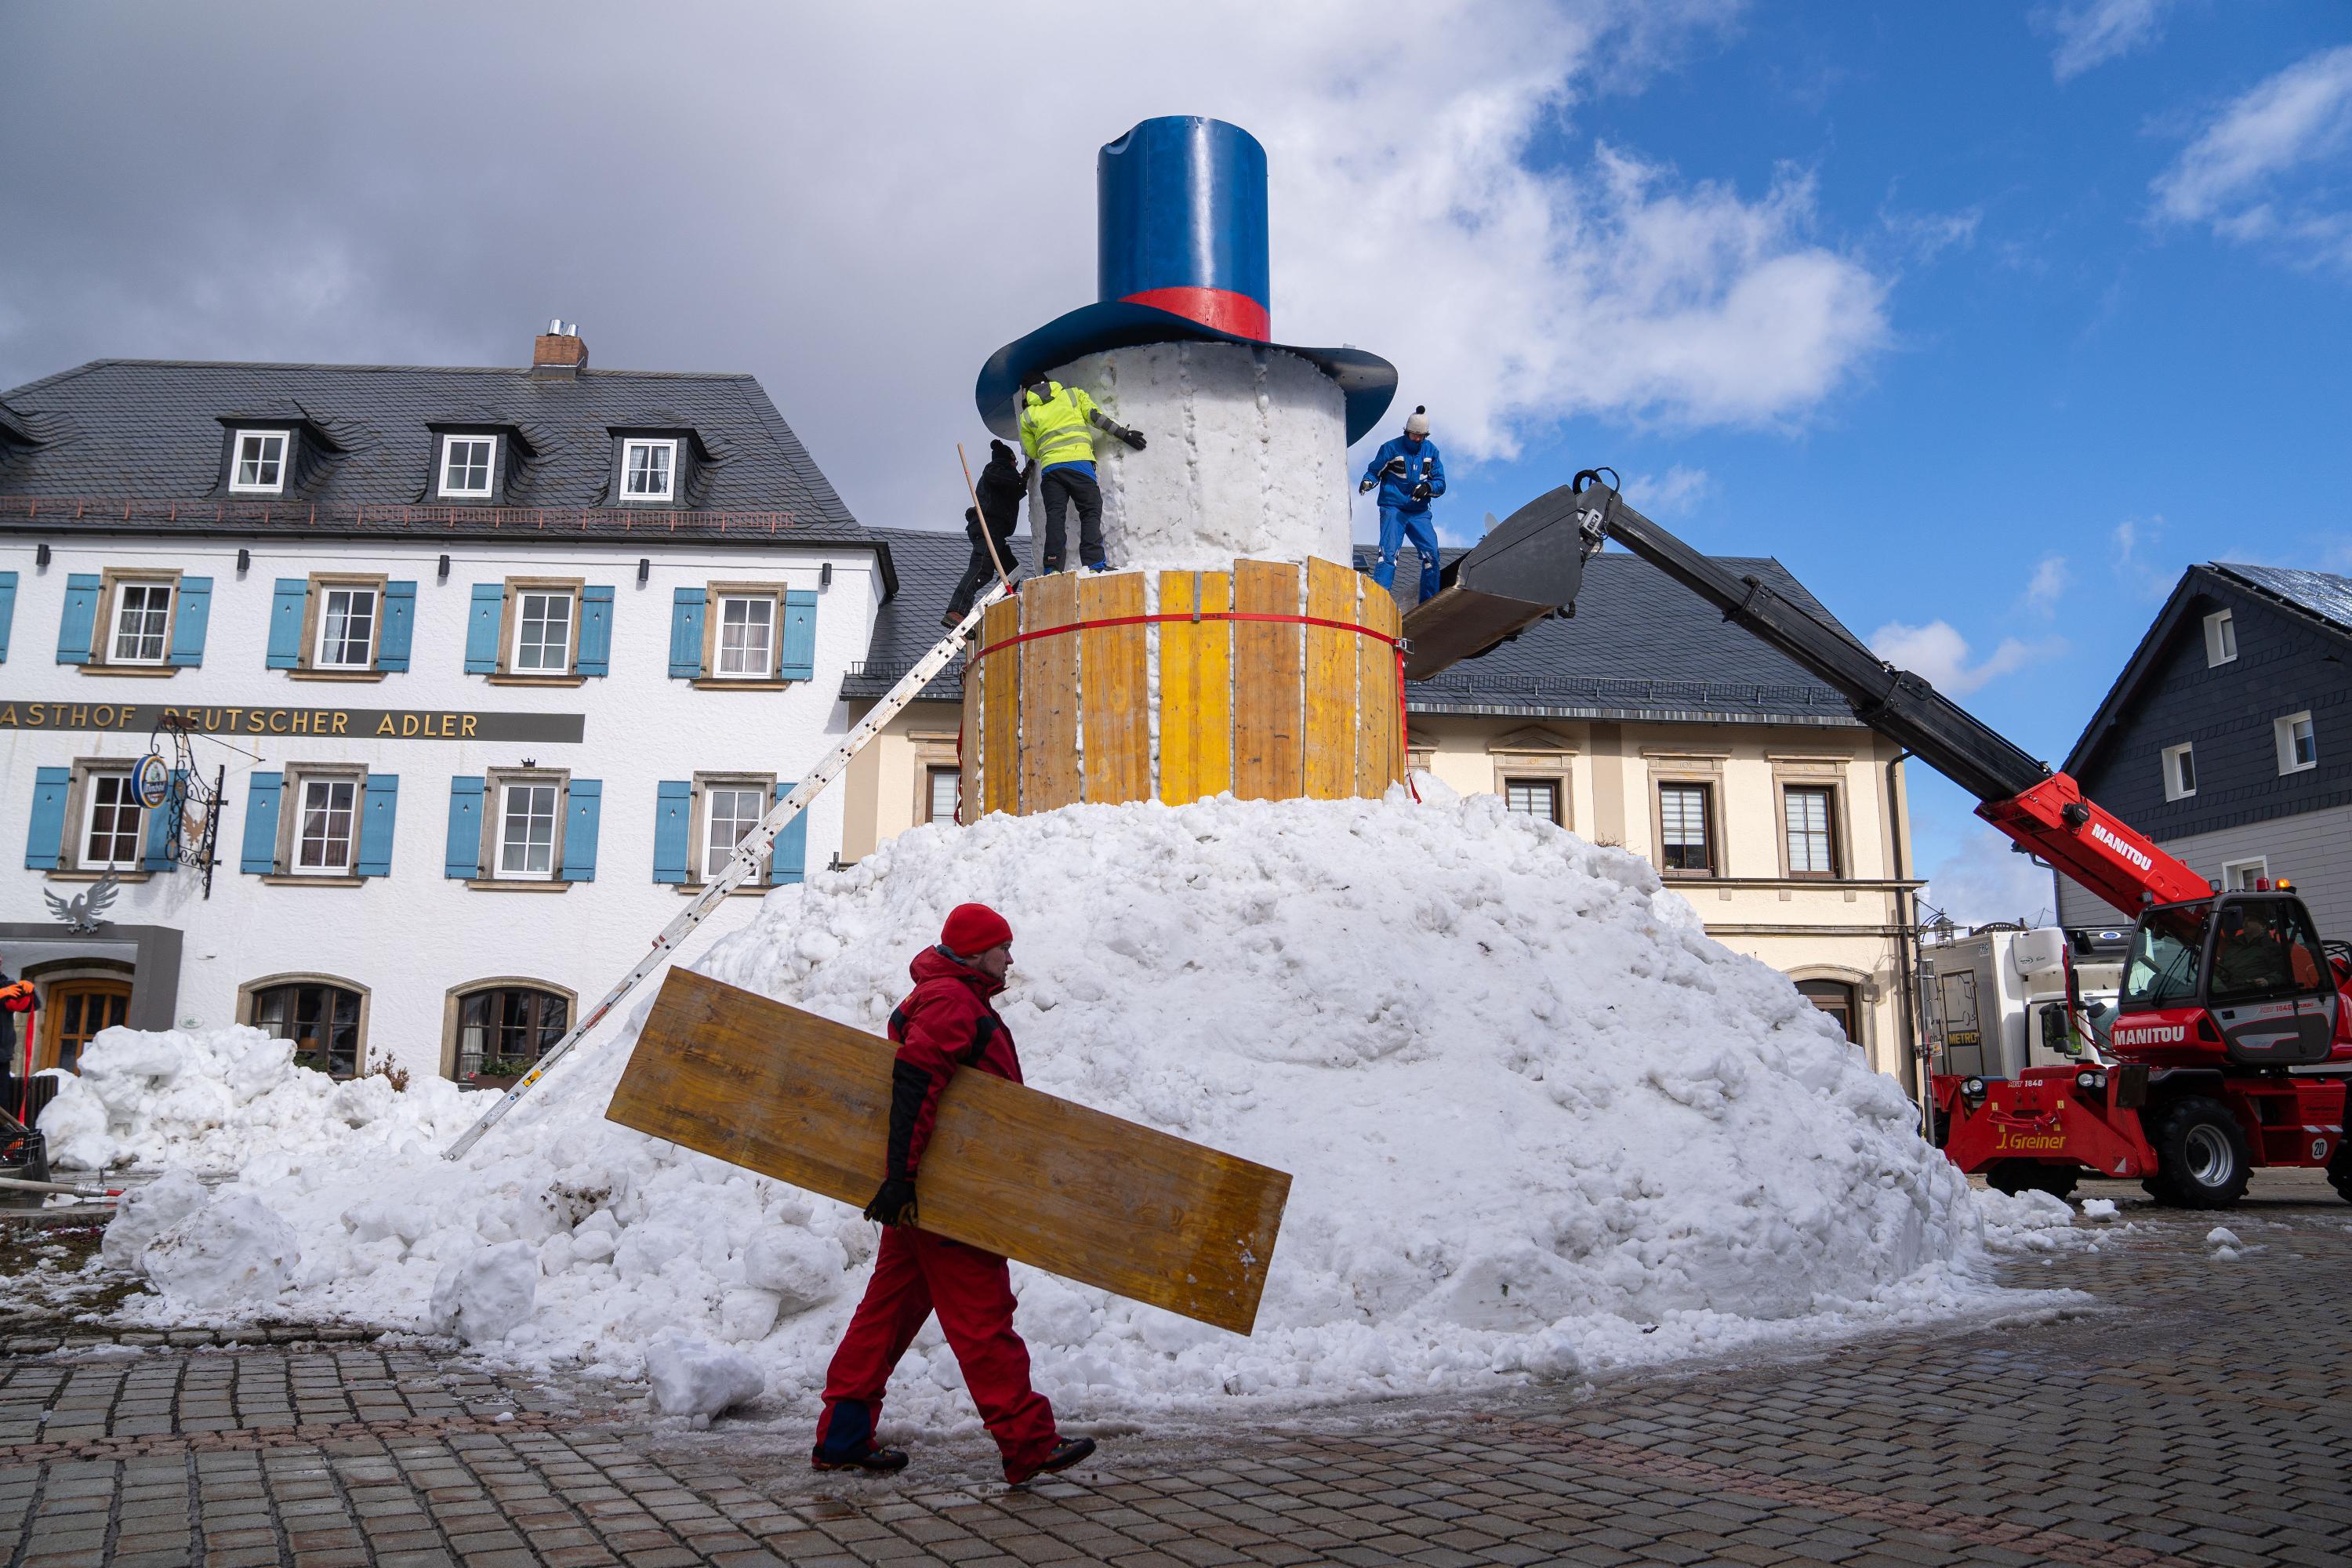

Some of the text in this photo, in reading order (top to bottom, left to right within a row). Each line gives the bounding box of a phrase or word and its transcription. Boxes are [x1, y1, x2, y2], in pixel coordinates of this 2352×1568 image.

[376, 713, 478, 737] ADLER
[2091, 822, 2152, 871] MANITOU
[2114, 1025, 2185, 1046] MANITOU
[2009, 1132, 2067, 1149] Greiner
[2314, 1142, 2325, 1156] 20
